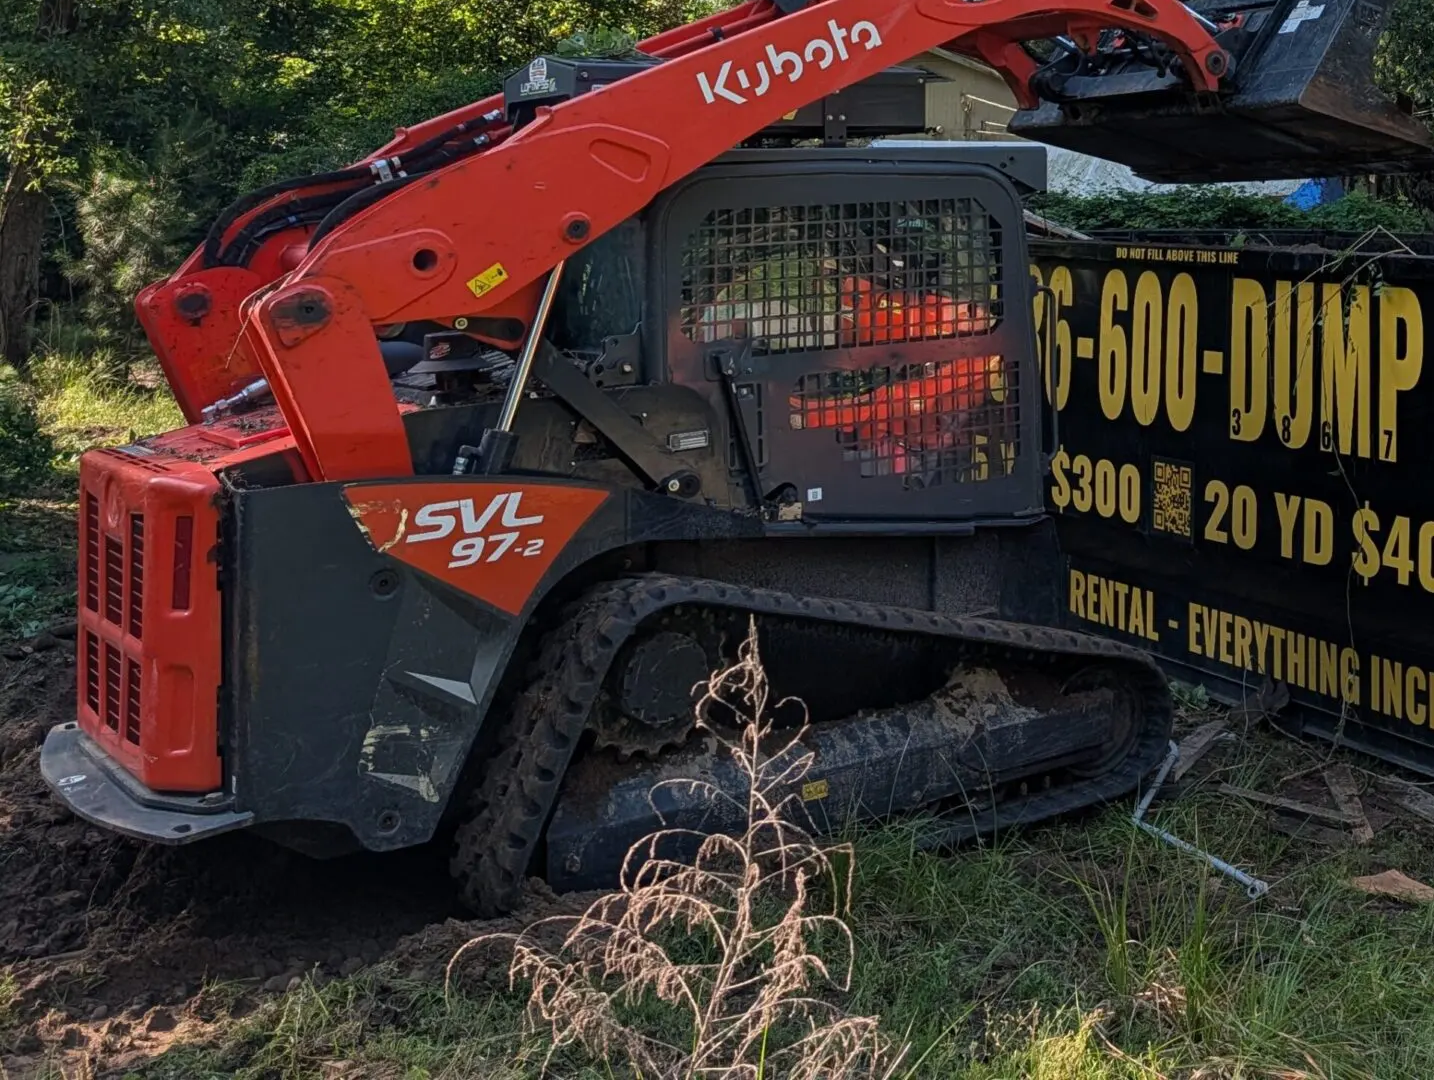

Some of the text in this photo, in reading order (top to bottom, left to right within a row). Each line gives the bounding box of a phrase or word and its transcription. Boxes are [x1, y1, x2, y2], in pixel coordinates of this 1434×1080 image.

[696, 19, 882, 104] Kubota
[1116, 247, 1239, 264] DO NOT FILL ABOVE THIS LINE
[405, 491, 544, 543] SVL
[1051, 444, 1140, 523] $300
[1204, 480, 1257, 550] 20
[1274, 491, 1333, 566] YD
[448, 531, 544, 569] 97-2
[1070, 568, 1158, 641] RENTAL
[1188, 602, 1360, 704] EVERYTHING
